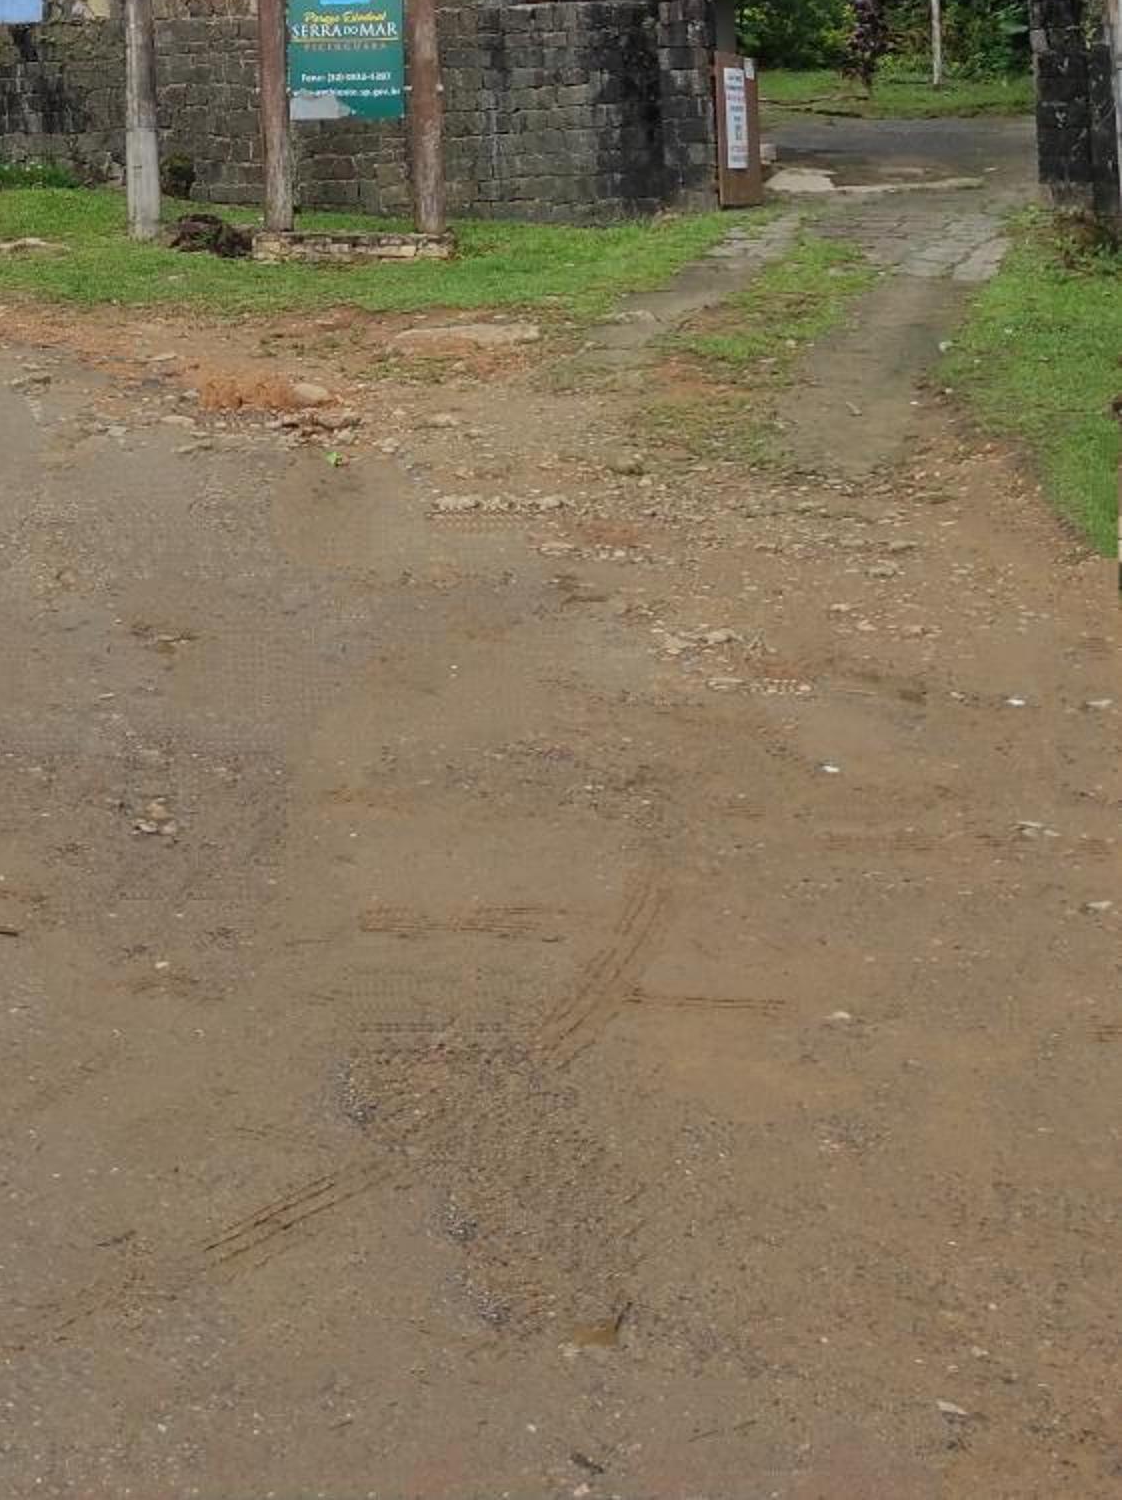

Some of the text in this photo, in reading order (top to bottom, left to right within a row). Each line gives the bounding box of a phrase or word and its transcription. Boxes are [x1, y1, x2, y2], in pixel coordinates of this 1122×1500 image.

[291, 21, 398, 37] SERRA DO MAR
